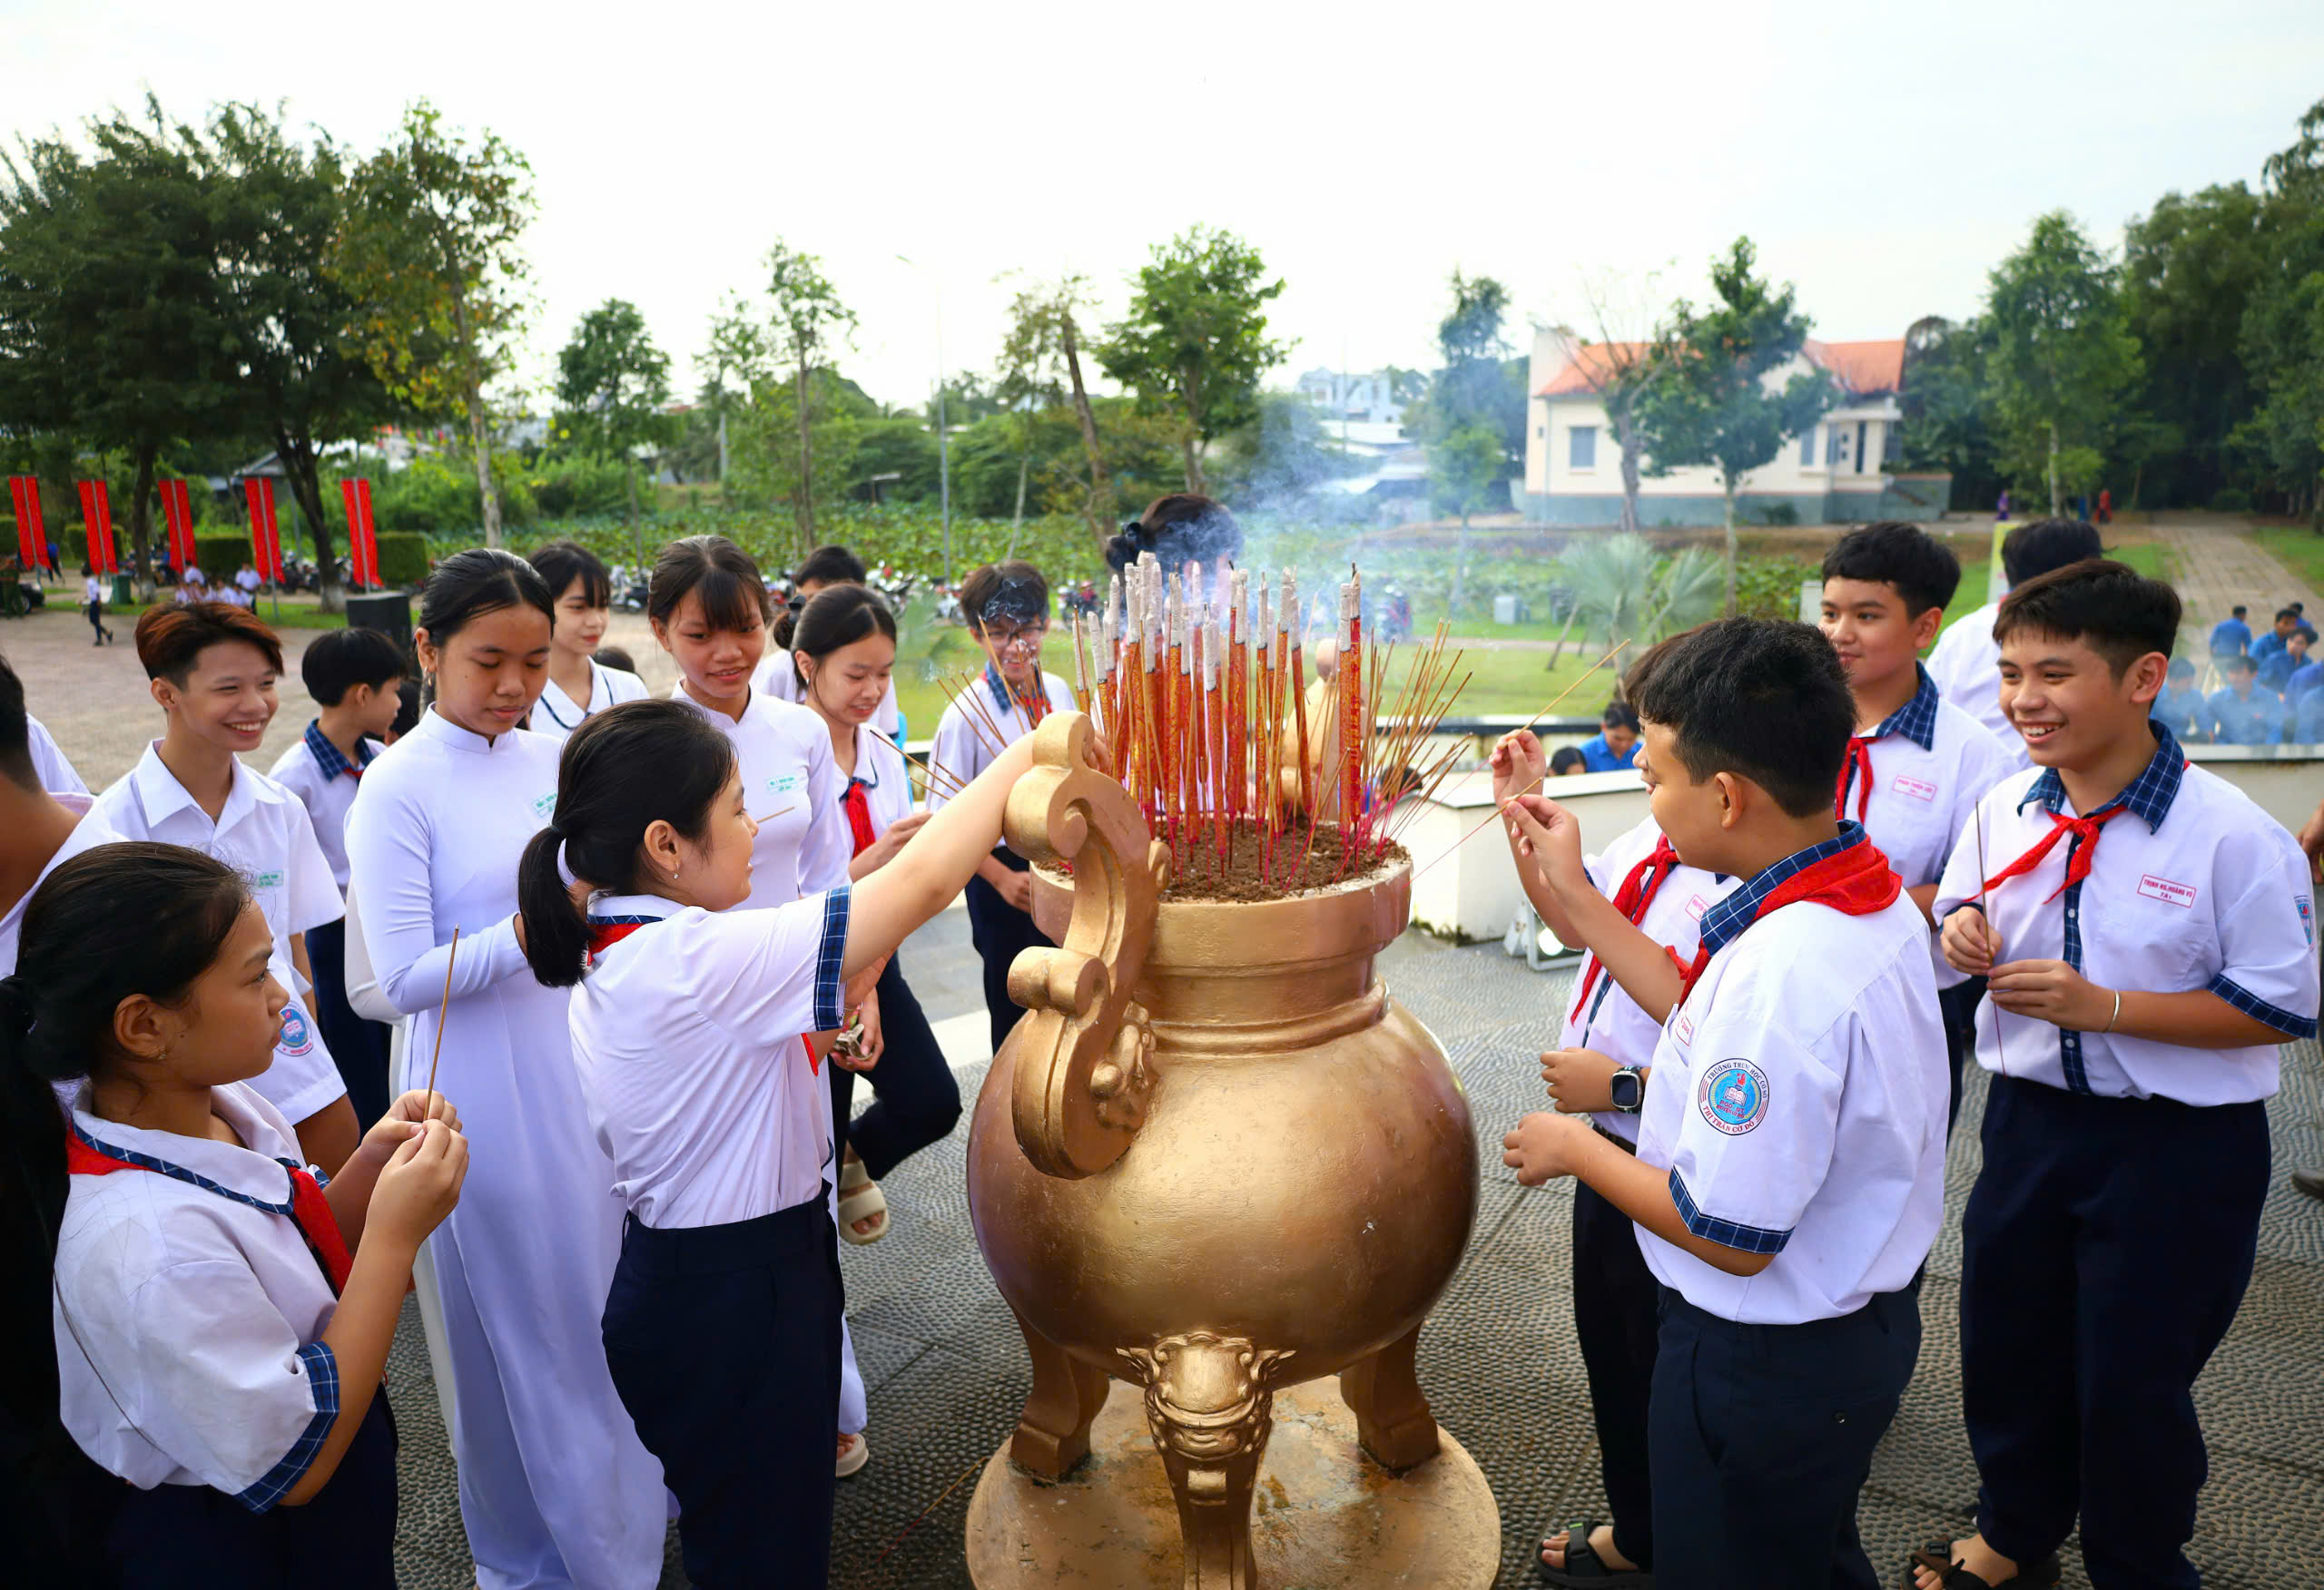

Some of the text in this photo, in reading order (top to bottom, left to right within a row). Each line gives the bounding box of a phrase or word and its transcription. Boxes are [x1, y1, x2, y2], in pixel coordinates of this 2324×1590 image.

[1708, 1063, 1732, 1080] TRƯỜNG
[1749, 1068, 1763, 1081] HỌC
[1703, 1105, 1714, 1120] THỊ
[1712, 1118, 1731, 1132] TRẤN
[1732, 1124, 1744, 1133] CỜ
